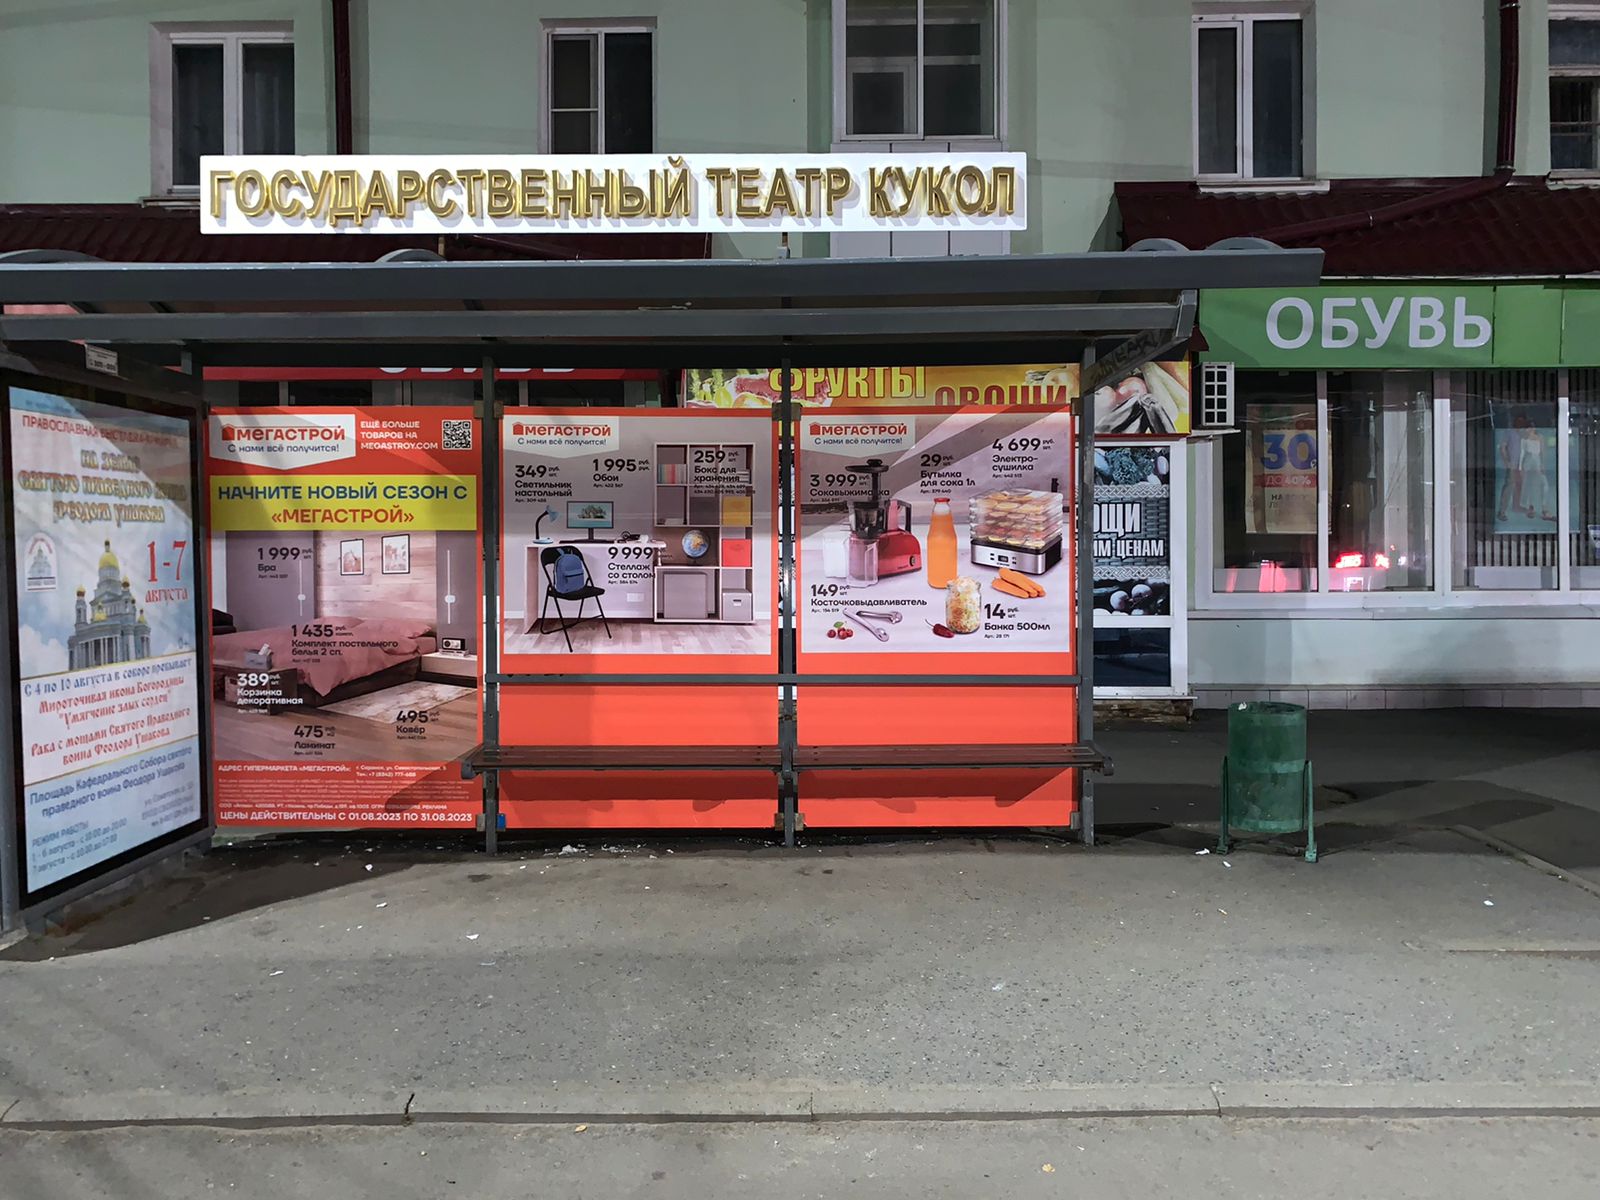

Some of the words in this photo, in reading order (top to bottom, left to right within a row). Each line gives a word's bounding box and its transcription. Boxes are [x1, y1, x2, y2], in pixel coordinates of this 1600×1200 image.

[209, 155, 690, 226] ГОСУДАРСТВЕННЫЙ
[706, 167, 853, 216] ТЕАТР
[869, 166, 1015, 216] КУКОЛ
[1266, 296, 1493, 349] ОБУВЬ
[769, 366, 926, 399] ФРУКТЫ
[22, 415, 100, 438] ПРАВОСЛАВНАЯ
[360, 420, 380, 429] ЕЩЁ
[382, 421, 420, 429] БОЛЬШЕ
[360, 432, 404, 440] ТОВАРОВ
[405, 432, 418, 440] НА
[549, 437, 562, 445] всё
[564, 438, 607, 447] получится!
[861, 438, 903, 446] получится!
[992, 438, 1003, 451] 4
[1008, 438, 1041, 451] 699
[228, 444, 235, 453] С
[239, 445, 264, 453] нами
[267, 443, 284, 453] всё
[287, 444, 339, 456] получится!
[694, 450, 726, 463] 259
[921, 454, 941, 467] 29
[992, 454, 1039, 463] Электро-
[593, 459, 599, 471] 1
[604, 458, 637, 472] 995
[694, 465, 718, 474] Бокс
[720, 466, 736, 475] для
[992, 464, 1034, 472] сушилка
[514, 465, 547, 478] 349
[920, 471, 962, 479] Бутылка
[593, 473, 619, 482] Обои
[694, 475, 740, 484] хранения
[810, 474, 820, 487] 3
[825, 474, 857, 487] 999
[920, 479, 937, 487] для
[966, 478, 976, 486] 1л
[515, 480, 572, 489] Светильник
[219, 486, 302, 500] НАЧНИТЕ
[308, 483, 377, 500] НОВЫЙ
[383, 485, 448, 500] СЕЗОН
[453, 485, 467, 500] С
[515, 489, 573, 497] настольный
[809, 488, 890, 497] Соковыжимака
[271, 505, 415, 524] «МЕГАСТРОЙ»
[269, 547, 300, 560] 999
[608, 546, 618, 559] 9
[622, 546, 653, 559] 999
[1116, 539, 1164, 559] ЦЕНАМ
[258, 563, 276, 573] Бра
[608, 562, 651, 571] Стеллаж
[811, 584, 838, 597] 149
[811, 598, 928, 607] Косточковыдавливатель
[984, 603, 1006, 619] 14
[302, 624, 333, 637] 435
[984, 622, 1014, 631] Банка
[1017, 622, 1051, 631] 500мл
[292, 639, 337, 649] Комплект
[339, 641, 399, 649] постельного
[292, 648, 318, 656] белья
[321, 648, 327, 656] 2
[329, 649, 343, 657] сп.
[237, 674, 268, 686] 389
[237, 688, 282, 698] Корзинка
[237, 697, 303, 706] декоративная
[396, 710, 429, 723] 495
[294, 726, 323, 738] 475
[396, 725, 426, 735] Ковёр
[294, 741, 335, 750] Ламинат
[30, 785, 75, 805] Площадь
[75, 763, 138, 791] Кафедрального
[220, 811, 248, 820] ЦЕНЫ
[250, 810, 336, 821] ДЕЙСТВИТЕЛЬНЫ
[338, 812, 346, 821] С
[348, 812, 401, 821] 01.08.2023
[403, 813, 418, 821] ПО
[420, 813, 473, 822] 31.08.2023
